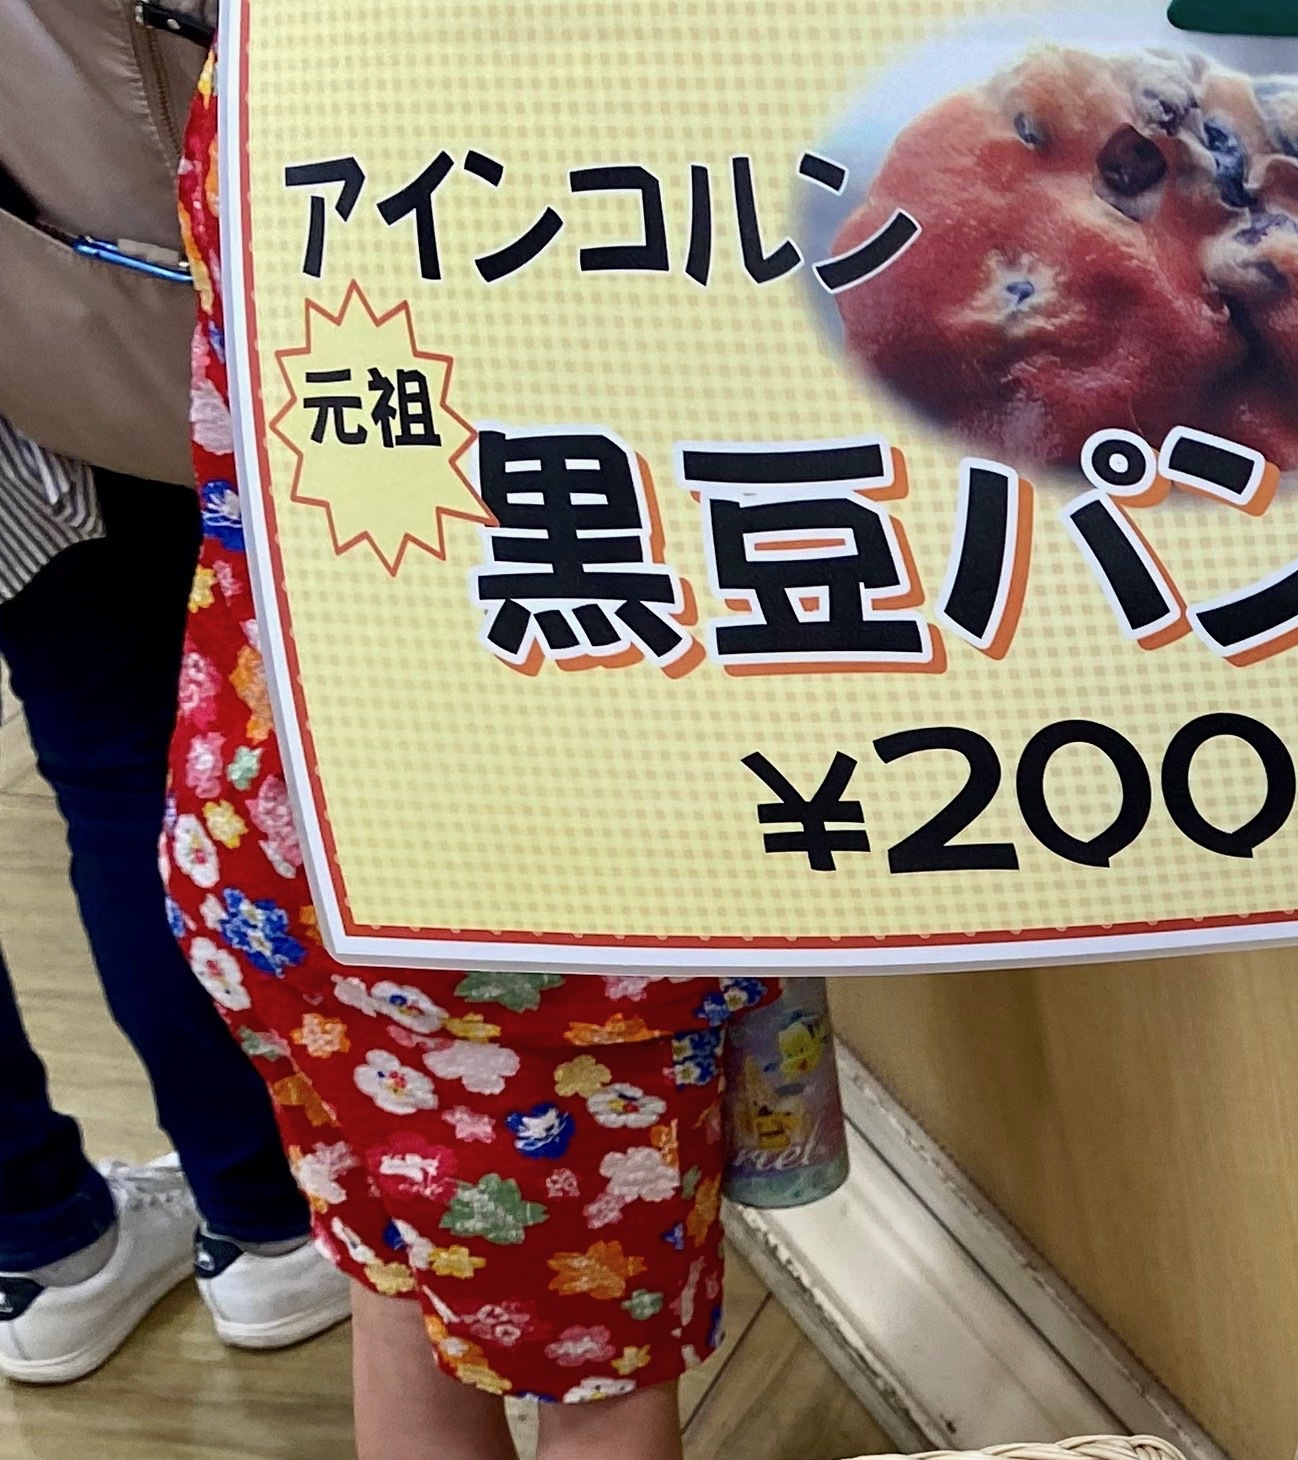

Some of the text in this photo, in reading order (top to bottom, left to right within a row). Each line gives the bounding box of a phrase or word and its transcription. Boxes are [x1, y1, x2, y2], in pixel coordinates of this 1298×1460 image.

[284, 149, 919, 292] アインコルン
[301, 366, 443, 449] 元祖
[740, 712, 1298, 874] ¥200
